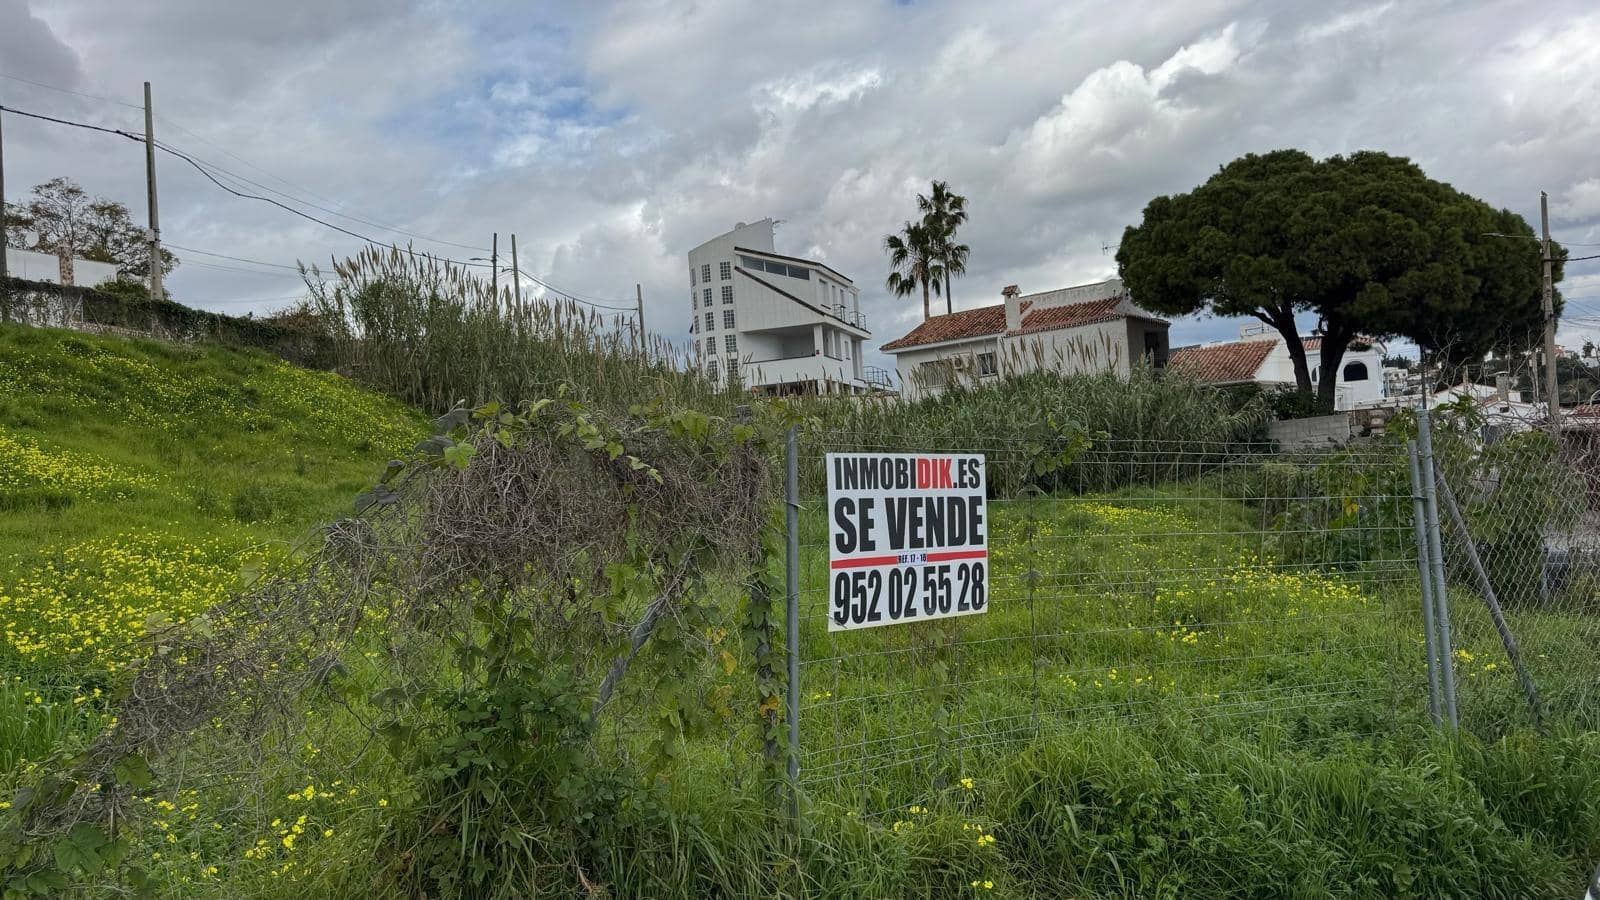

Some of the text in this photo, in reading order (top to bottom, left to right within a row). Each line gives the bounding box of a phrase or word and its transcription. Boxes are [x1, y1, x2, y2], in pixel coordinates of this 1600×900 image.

[834, 457, 981, 490] INMOBIDIK.ES
[834, 495, 984, 554] SE VENDE
[833, 562, 985, 625] 952 02 55 28
